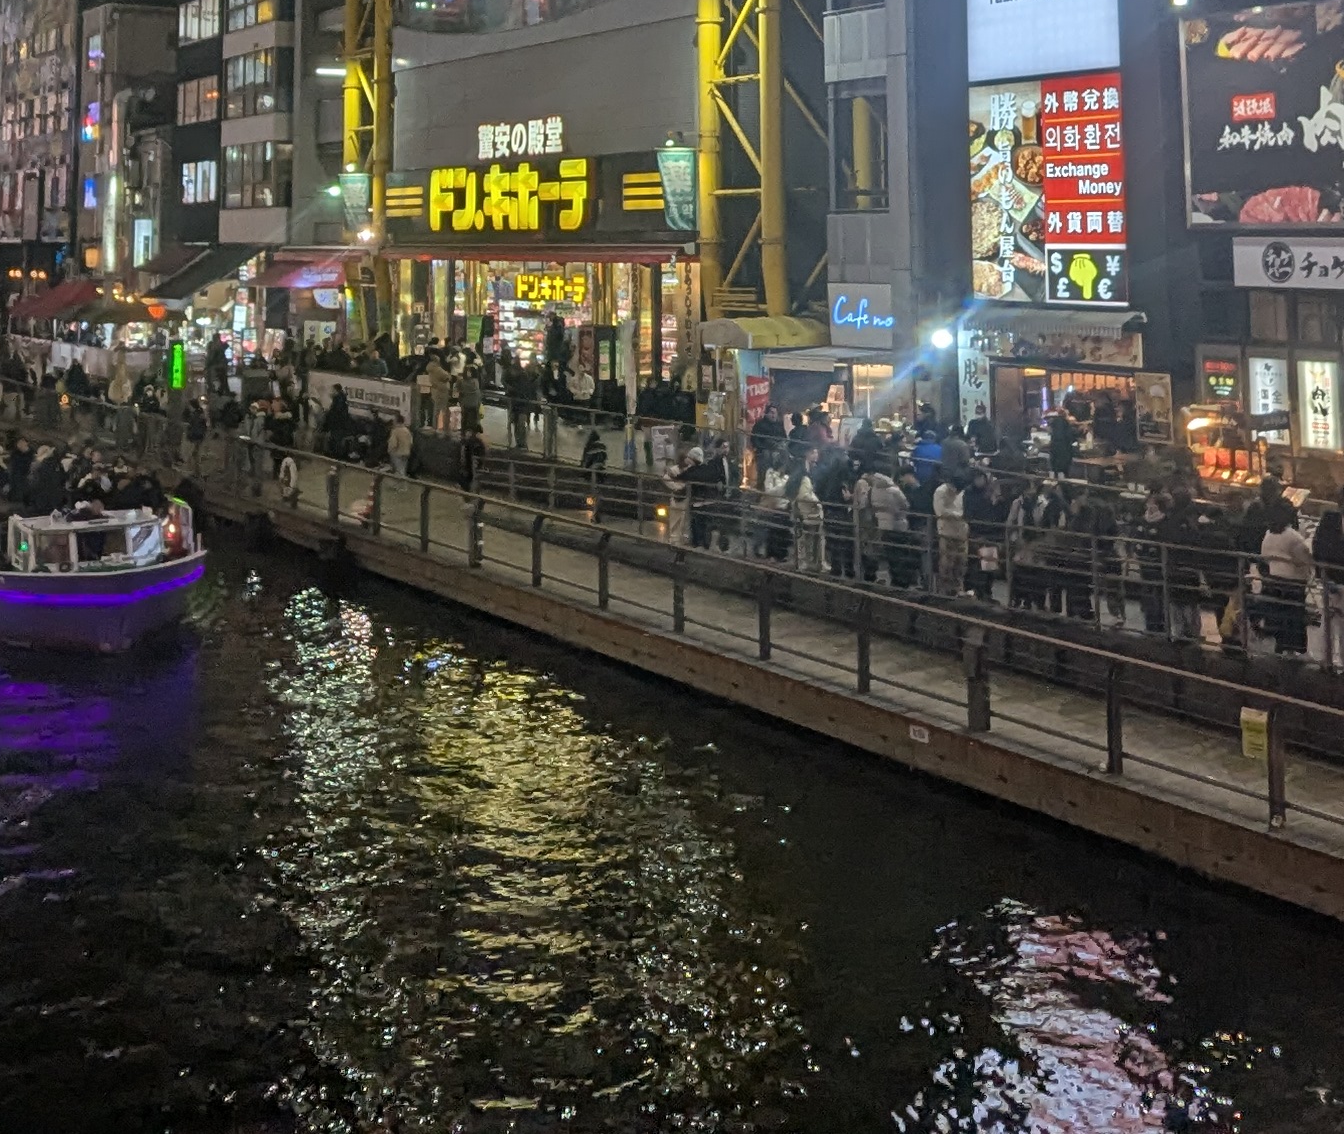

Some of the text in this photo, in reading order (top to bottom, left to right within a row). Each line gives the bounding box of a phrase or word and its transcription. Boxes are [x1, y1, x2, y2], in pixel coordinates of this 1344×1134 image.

[989, 92, 1018, 131] 勝
[1044, 88, 1120, 114] 外幣兌換
[477, 116, 563, 159] 驚安の殿堂
[1045, 122, 1122, 152] 외화환전
[1217, 121, 1295, 152] 和牛焼肉
[1046, 162, 1109, 178] Exchange
[1078, 179, 1123, 196] Money
[1047, 210, 1124, 234] 外貨両替
[1050, 252, 1121, 276] $ ¥
[1056, 278, 1113, 300] £ €
[833, 295, 870, 330] Cafe
